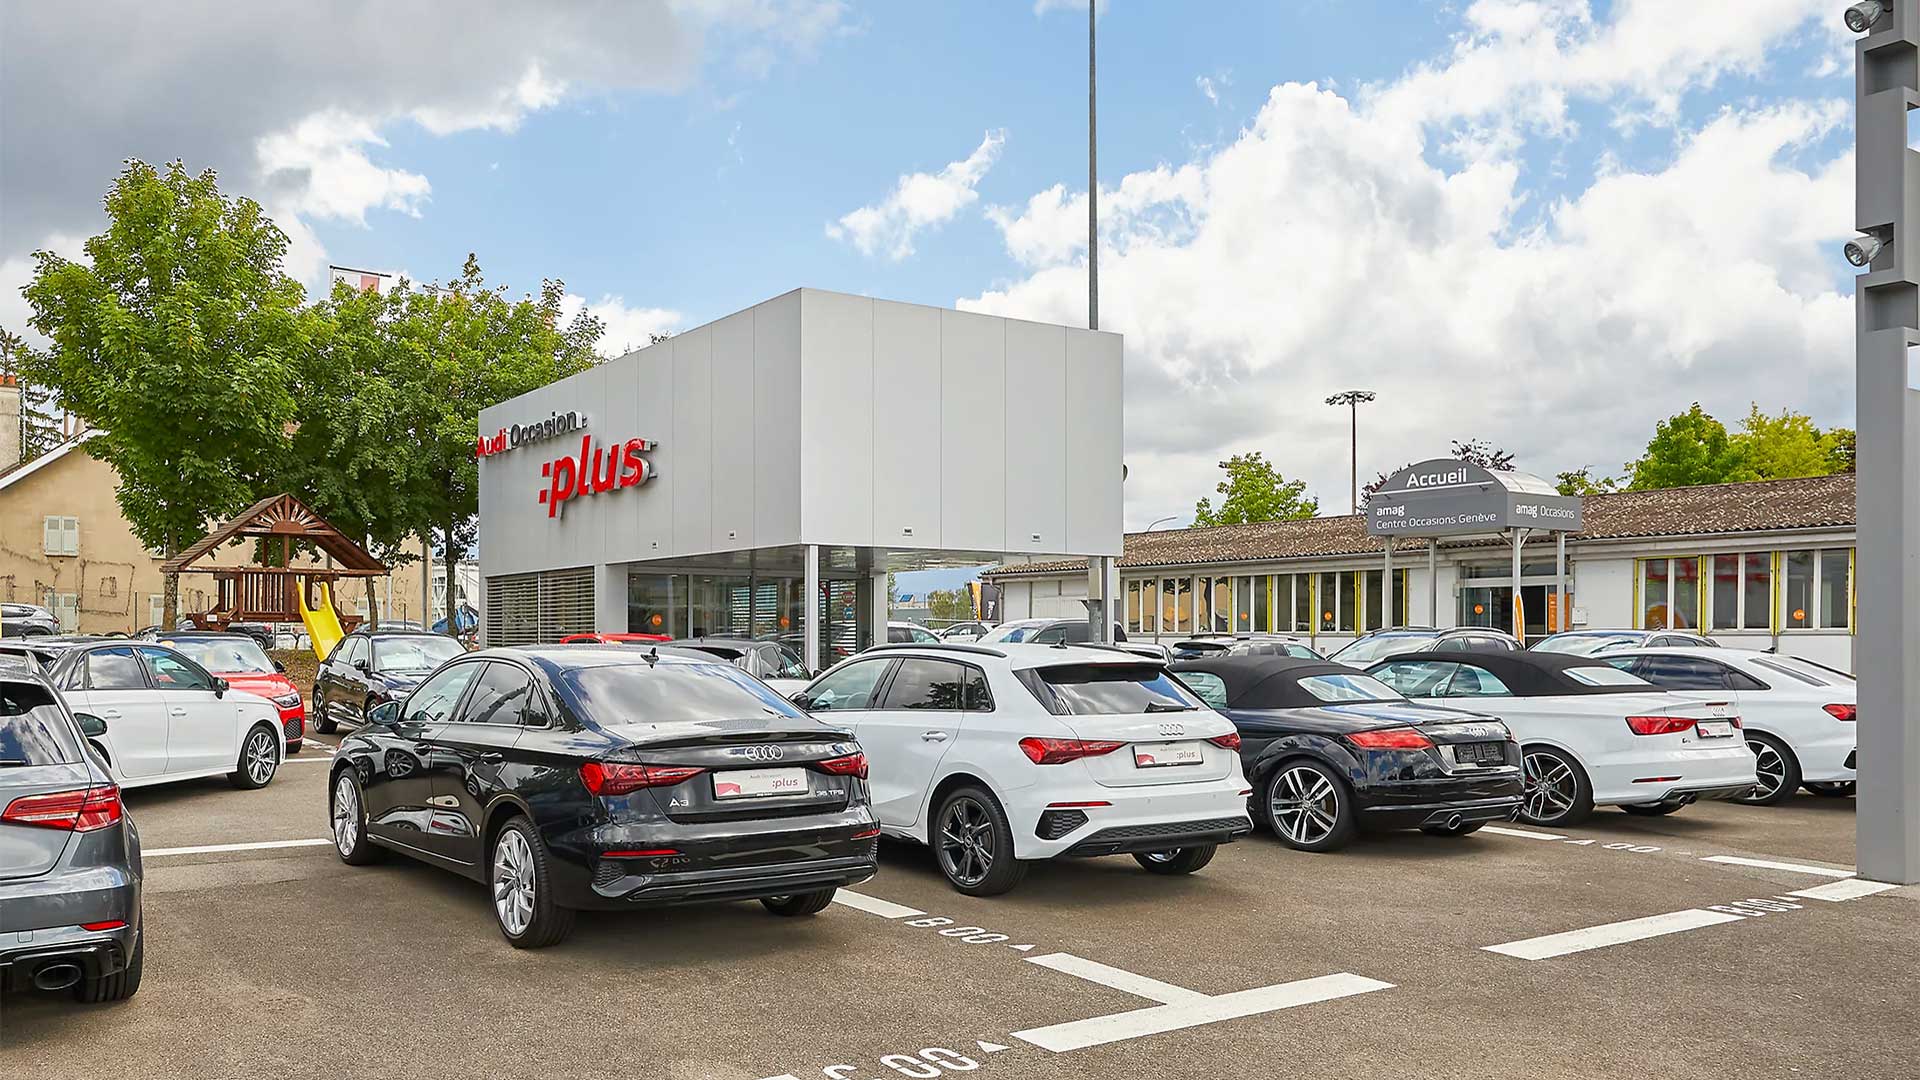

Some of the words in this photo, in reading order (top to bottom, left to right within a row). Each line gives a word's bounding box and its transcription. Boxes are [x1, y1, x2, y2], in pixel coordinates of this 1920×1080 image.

[476, 427, 507, 458] Audi
[510, 411, 578, 449] Occasion
[1406, 467, 1467, 488] Accueil
[1376, 504, 1405, 517] amag
[1515, 503, 1538, 519] amag
[1540, 506, 1575, 519] Occasions
[1376, 518, 1407, 530] Centre
[1408, 516, 1456, 527] Occasions
[1458, 512, 1497, 524] Genève
[669, 797, 689, 807] A3
